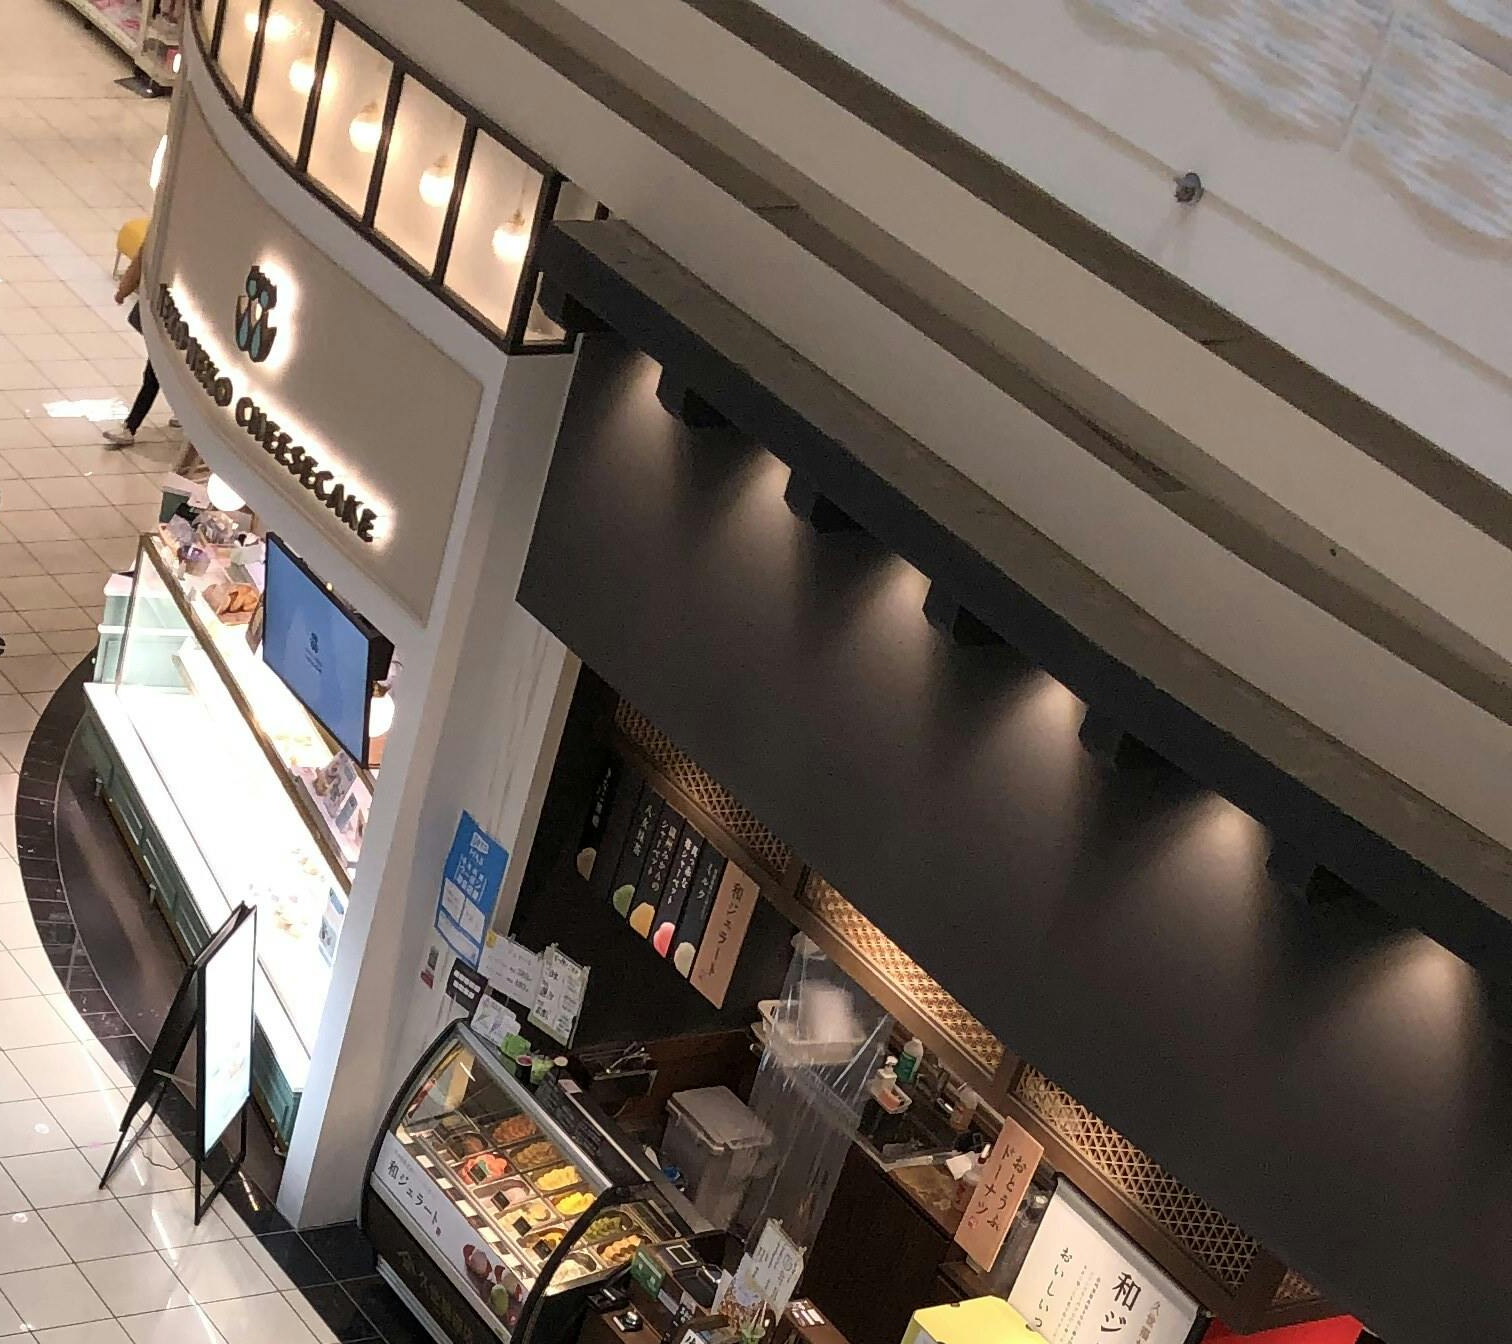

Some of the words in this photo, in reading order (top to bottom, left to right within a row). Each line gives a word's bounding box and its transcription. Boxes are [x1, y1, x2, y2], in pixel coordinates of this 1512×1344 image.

[235, 396, 377, 543] CHEESECAKE
[975, 1144, 1016, 1215] ドーナツ
[986, 1155, 1028, 1233] おとうふ
